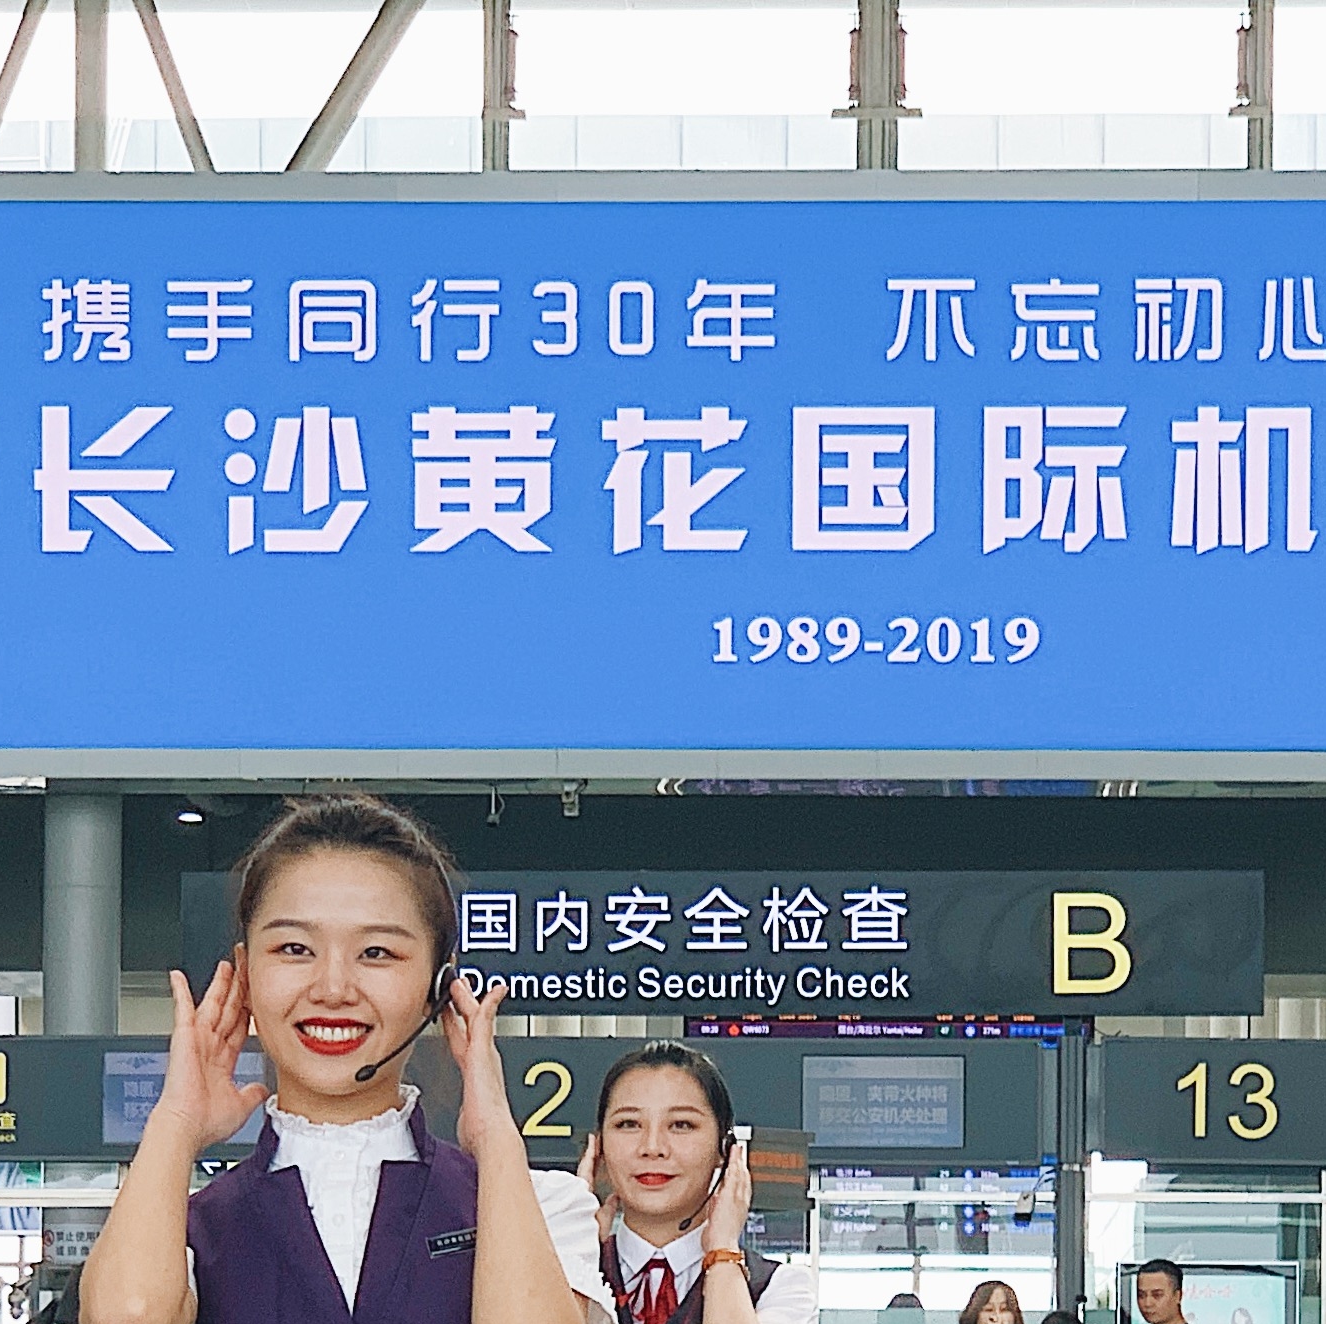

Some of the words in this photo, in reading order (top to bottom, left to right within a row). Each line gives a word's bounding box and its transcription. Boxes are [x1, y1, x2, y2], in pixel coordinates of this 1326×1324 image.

[41, 278, 778, 362] 携手同行30年
[712, 616, 1043, 665] 1989-2019
[460, 886, 909, 954] 国内安全检查
[1053, 893, 1132, 995] B
[460, 967, 627, 1000] Domestic
[638, 967, 787, 1006] Security
[797, 967, 910, 999] Check
[1176, 1062, 1279, 1140] 13
